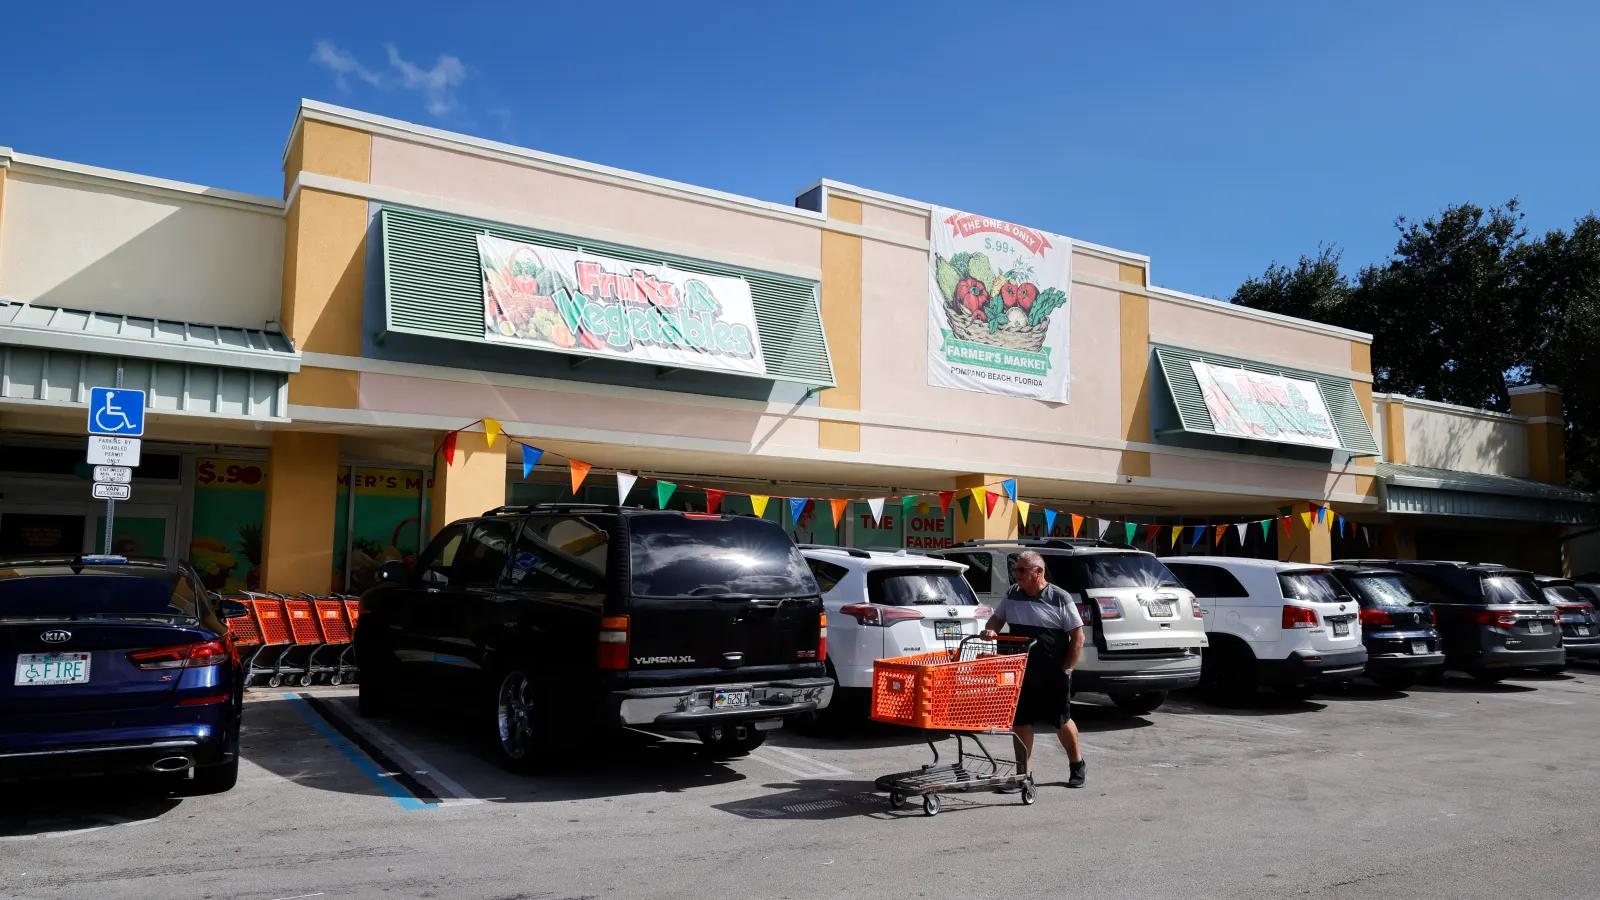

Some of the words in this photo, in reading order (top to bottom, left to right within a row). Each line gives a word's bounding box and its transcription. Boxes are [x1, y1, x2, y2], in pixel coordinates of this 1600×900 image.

[963, 219, 982, 232] THE
[982, 219, 1002, 230] ONE
[1004, 224, 1011, 232] &
[1012, 227, 1036, 246] ONLY
[575, 260, 679, 308] Fruits
[685, 279, 720, 314] &
[552, 287, 754, 358] Vegetables
[947, 345, 1001, 364] FARMER'S
[1004, 354, 1046, 370] MARKET
[1014, 376, 1043, 387] FLORIDA
[912, 518, 945, 532] ONE
[46, 633, 66, 641] KIA
[634, 656, 678, 664] YUKON
[678, 655, 696, 663] XL
[44, 661, 83, 678] FIRE
